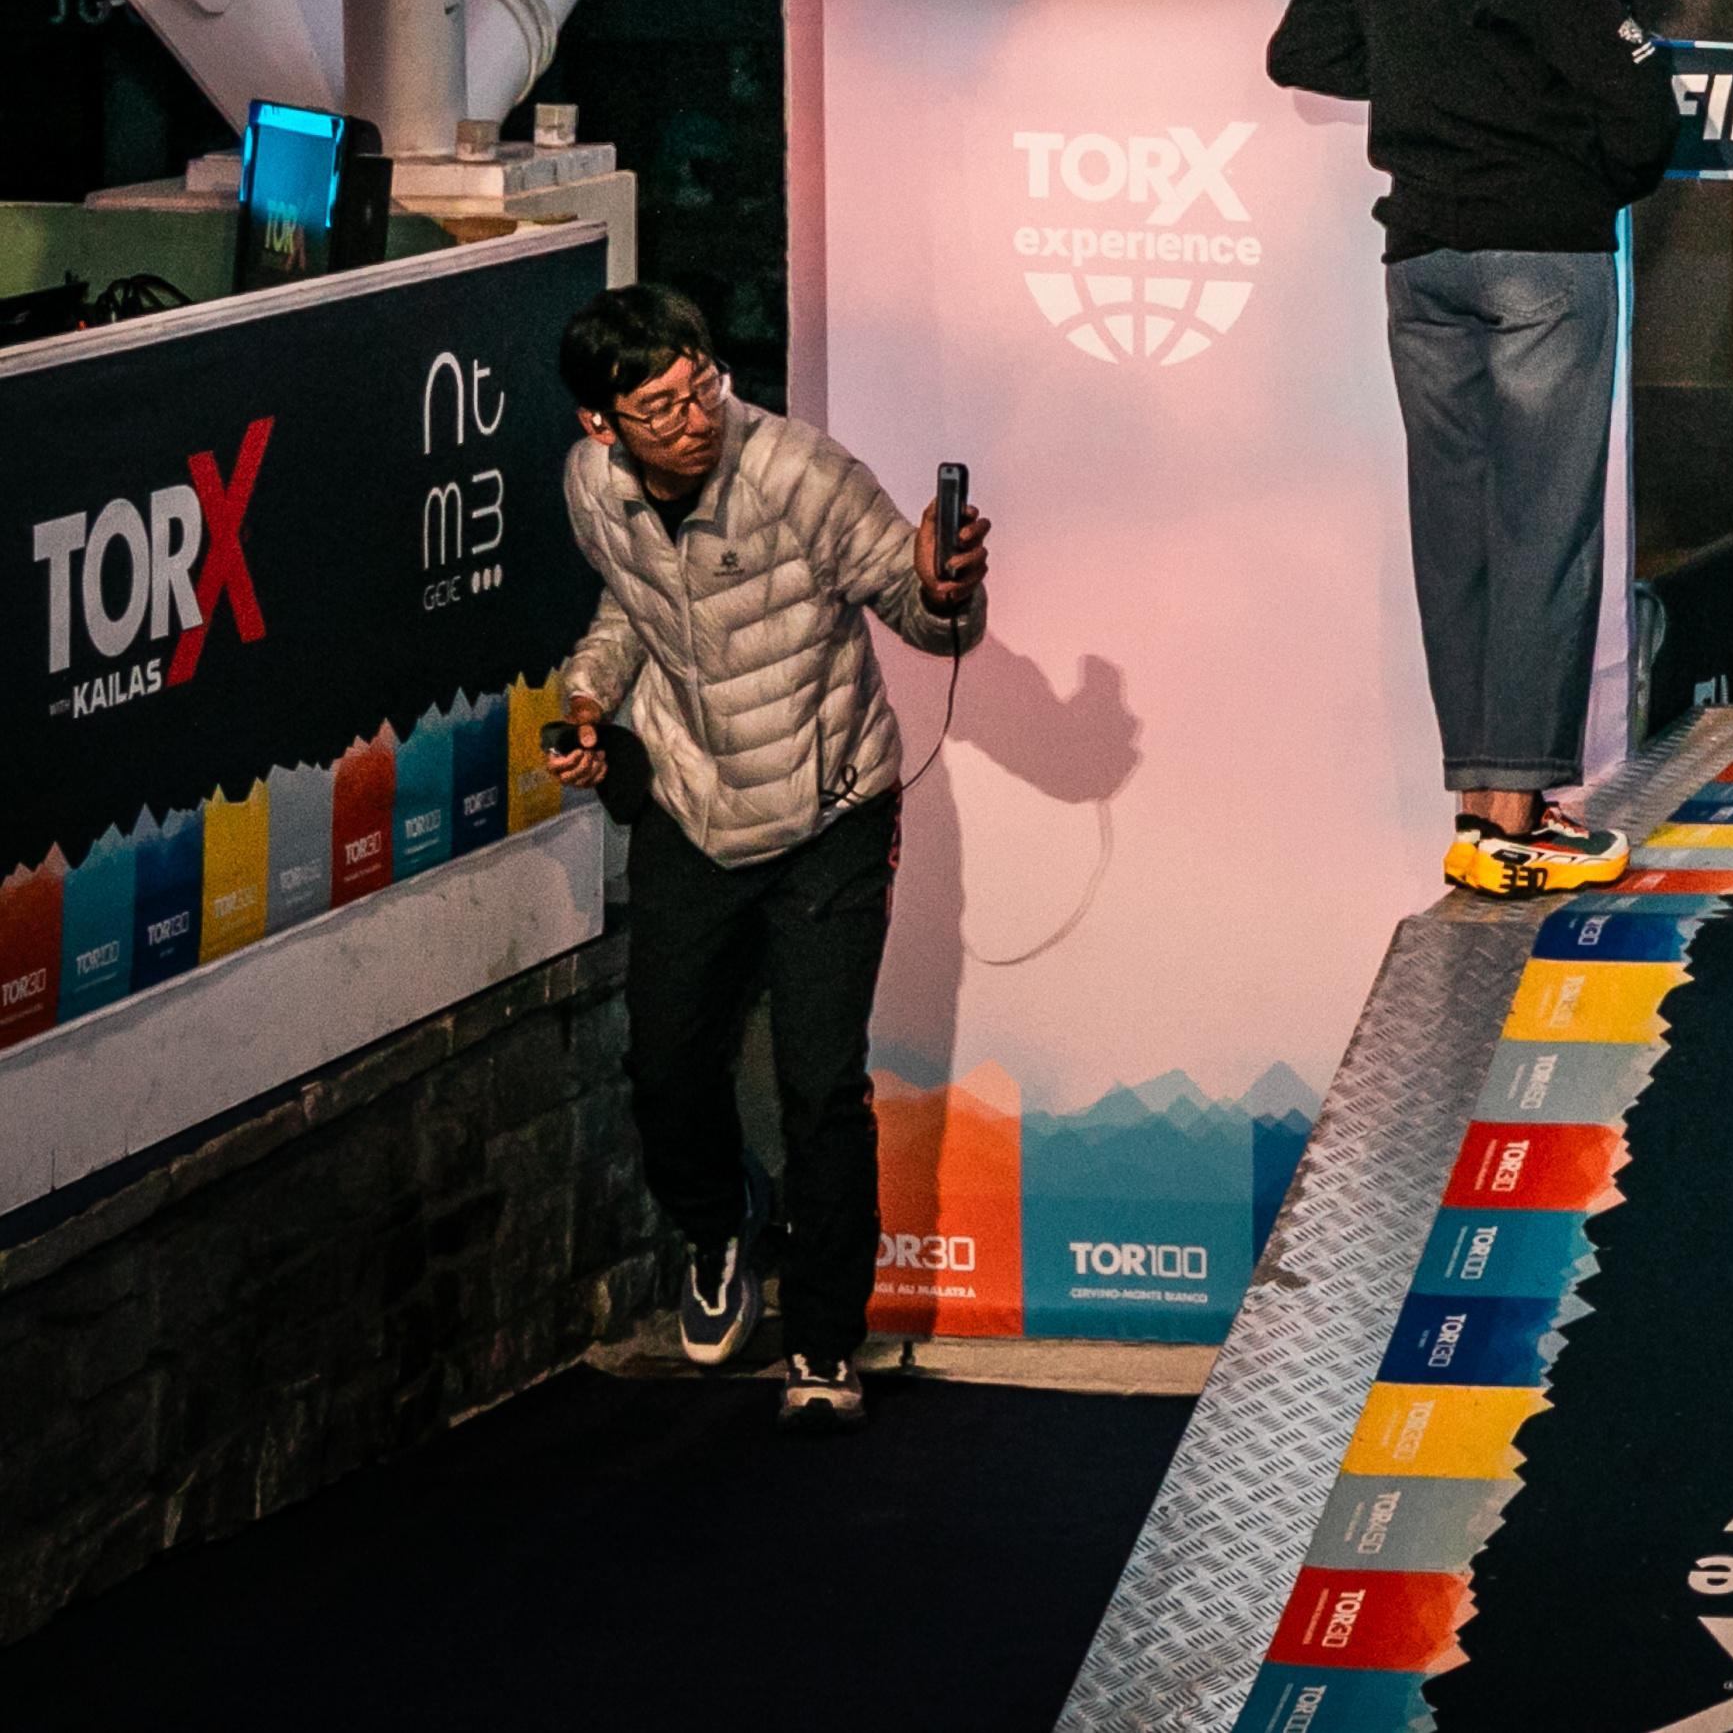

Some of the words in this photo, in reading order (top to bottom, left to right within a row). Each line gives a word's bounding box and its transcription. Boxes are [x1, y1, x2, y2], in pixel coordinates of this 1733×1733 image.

[1012, 121, 1260, 227] TORX
[1012, 226, 1263, 267] experience
[33, 415, 276, 688] TORX
[73, 659, 163, 719] KAILAS
[2, 967, 48, 1008] TOR30
[875, 1234, 976, 1272] OR30
[1069, 1242, 1208, 1279] TOR100
[1427, 1312, 1468, 1369] TOR130
[1320, 1588, 1367, 1649] TOR30
